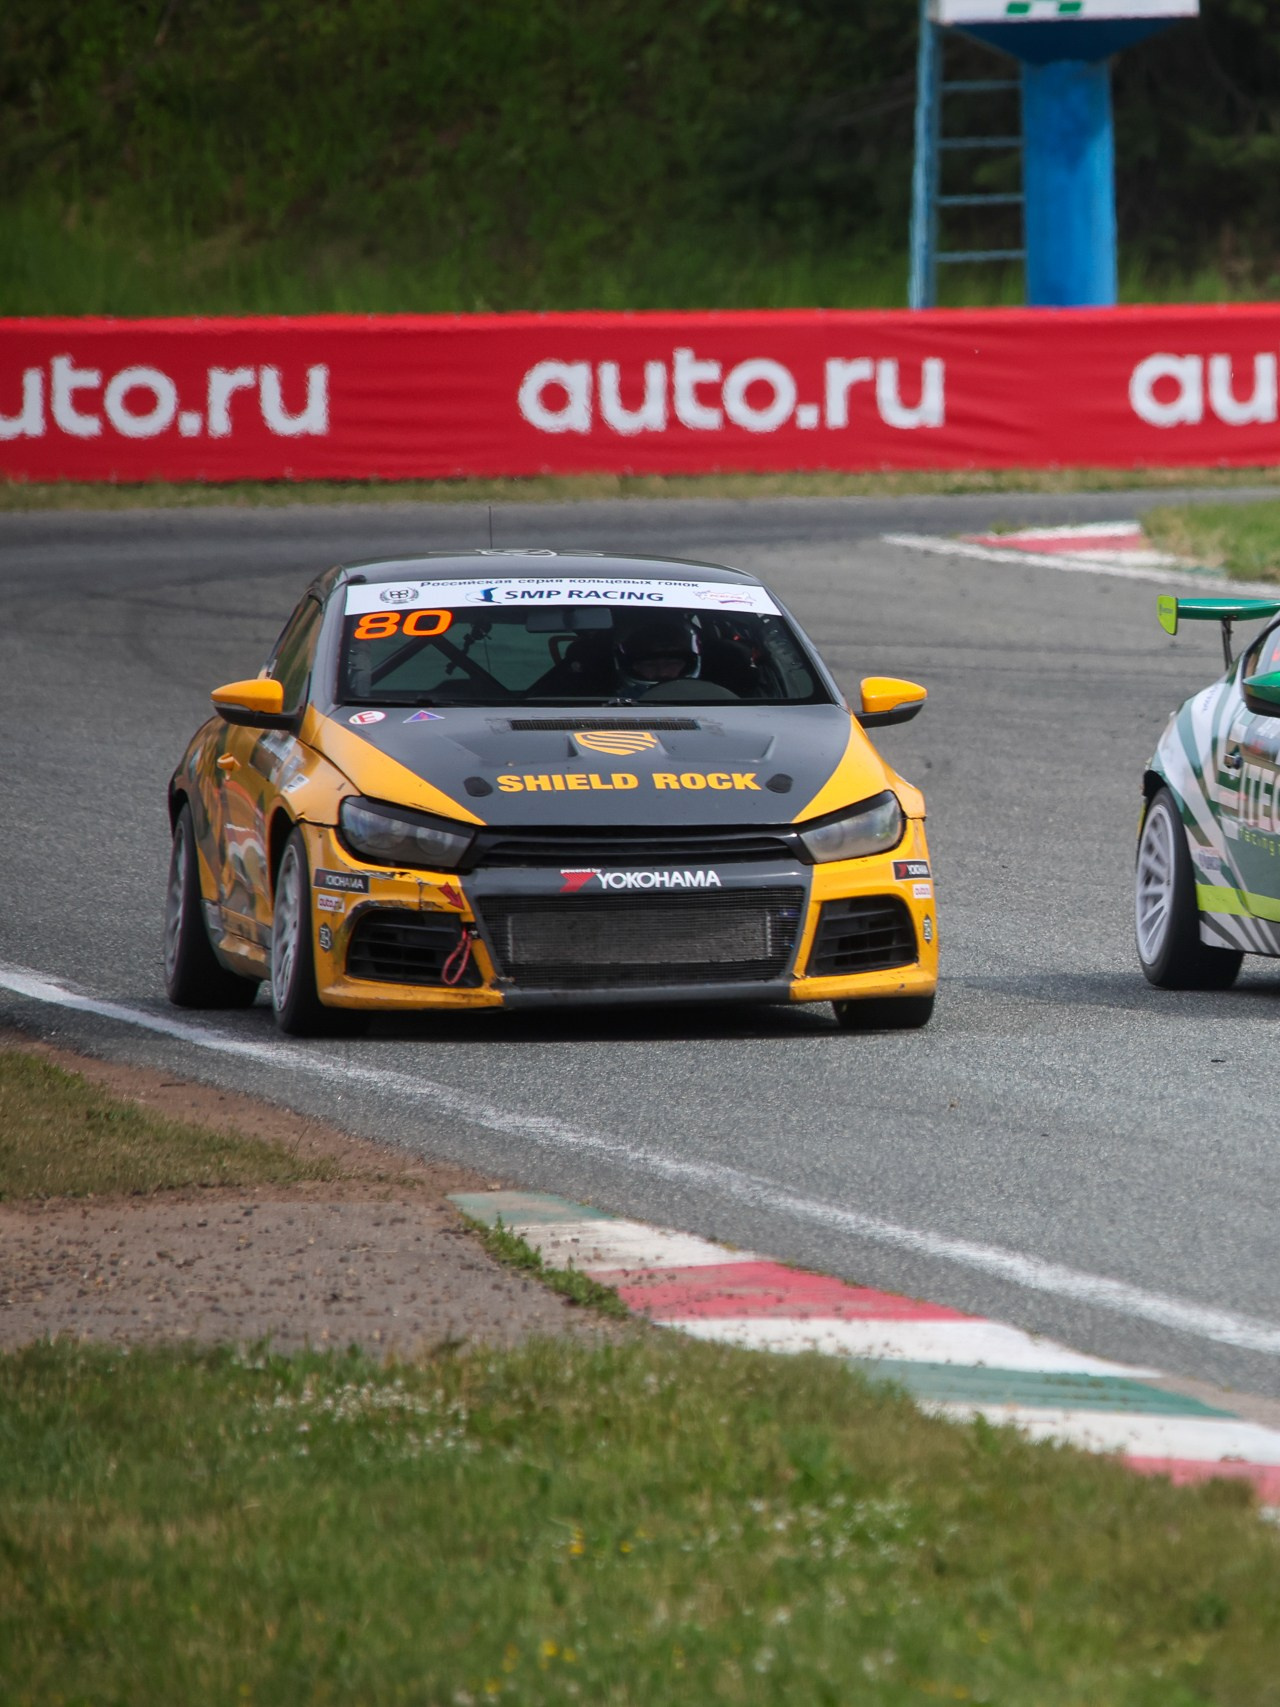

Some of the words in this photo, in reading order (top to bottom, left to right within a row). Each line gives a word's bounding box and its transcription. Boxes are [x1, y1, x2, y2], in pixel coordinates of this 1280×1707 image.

[518, 347, 945, 436] auto.ru
[504, 590, 562, 600] SMP
[567, 590, 664, 602] RACING
[354, 609, 453, 640] 80
[496, 773, 639, 792] SHIELD
[652, 773, 762, 791] ROCK
[597, 870, 722, 889] YOKOHAMA
